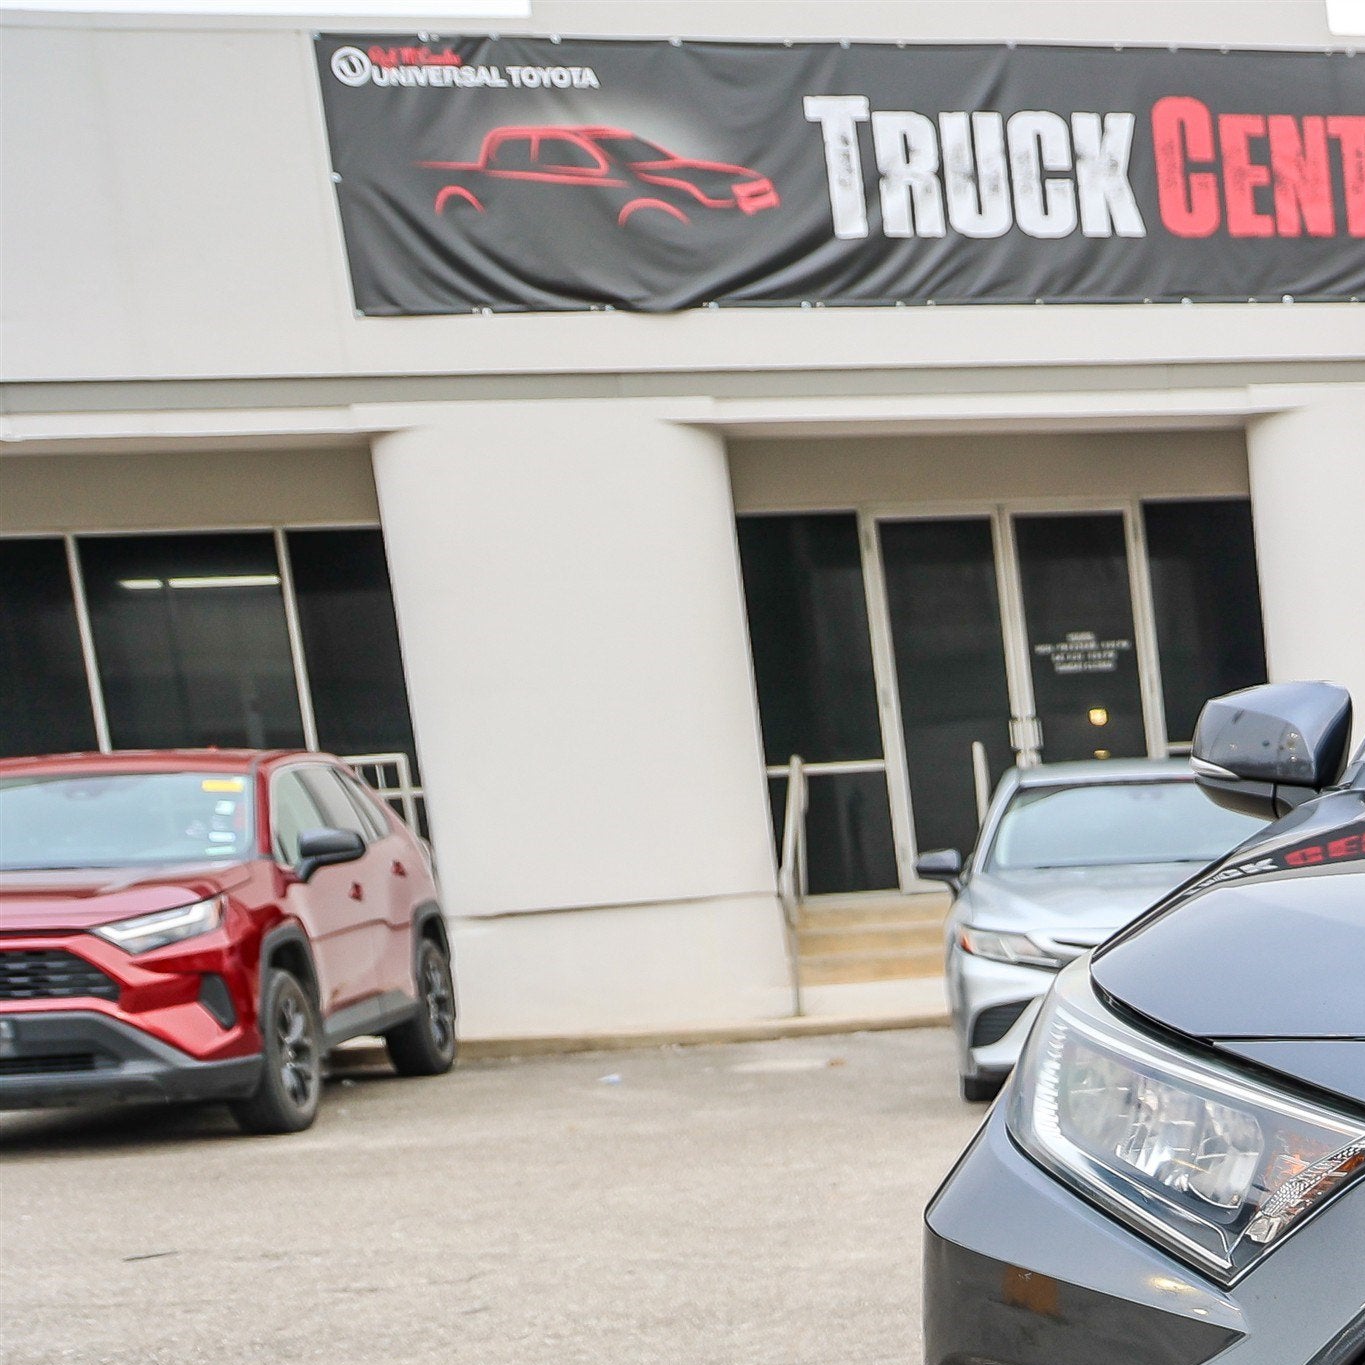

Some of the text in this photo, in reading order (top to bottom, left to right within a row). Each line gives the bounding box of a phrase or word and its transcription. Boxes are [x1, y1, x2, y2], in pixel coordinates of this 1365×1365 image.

[371, 65, 600, 89] UNIVERSAL TOYOTA
[803, 95, 1147, 239] TRUCK
